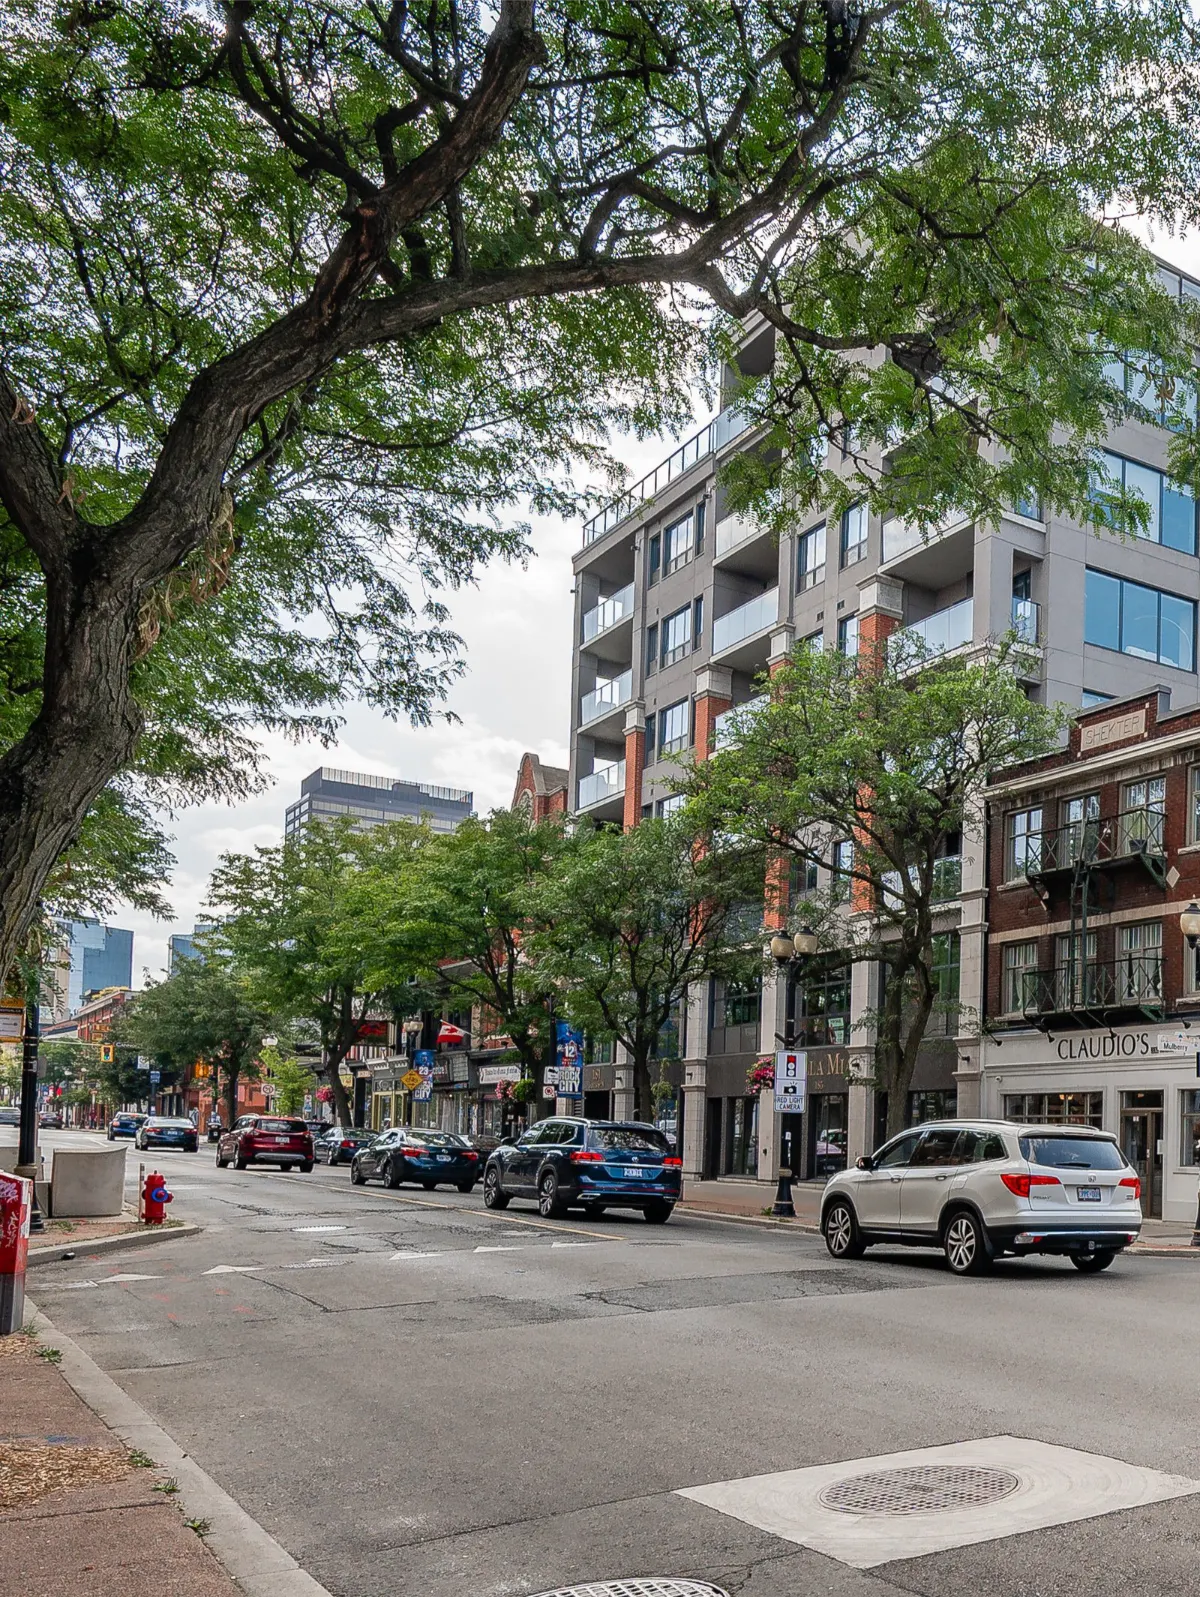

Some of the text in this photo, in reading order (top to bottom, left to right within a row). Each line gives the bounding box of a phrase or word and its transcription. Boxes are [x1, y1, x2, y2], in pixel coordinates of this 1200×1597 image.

[1085, 715, 1140, 745] SHEKTER
[565, 1046, 575, 1058] 12
[1057, 1033, 1149, 1060] CLAUDIO'S
[1163, 1042, 1188, 1051] Mulberry
[419, 1066, 429, 1075] 23
[559, 1070, 580, 1081] ROCK
[559, 1080, 580, 1092] CITY
